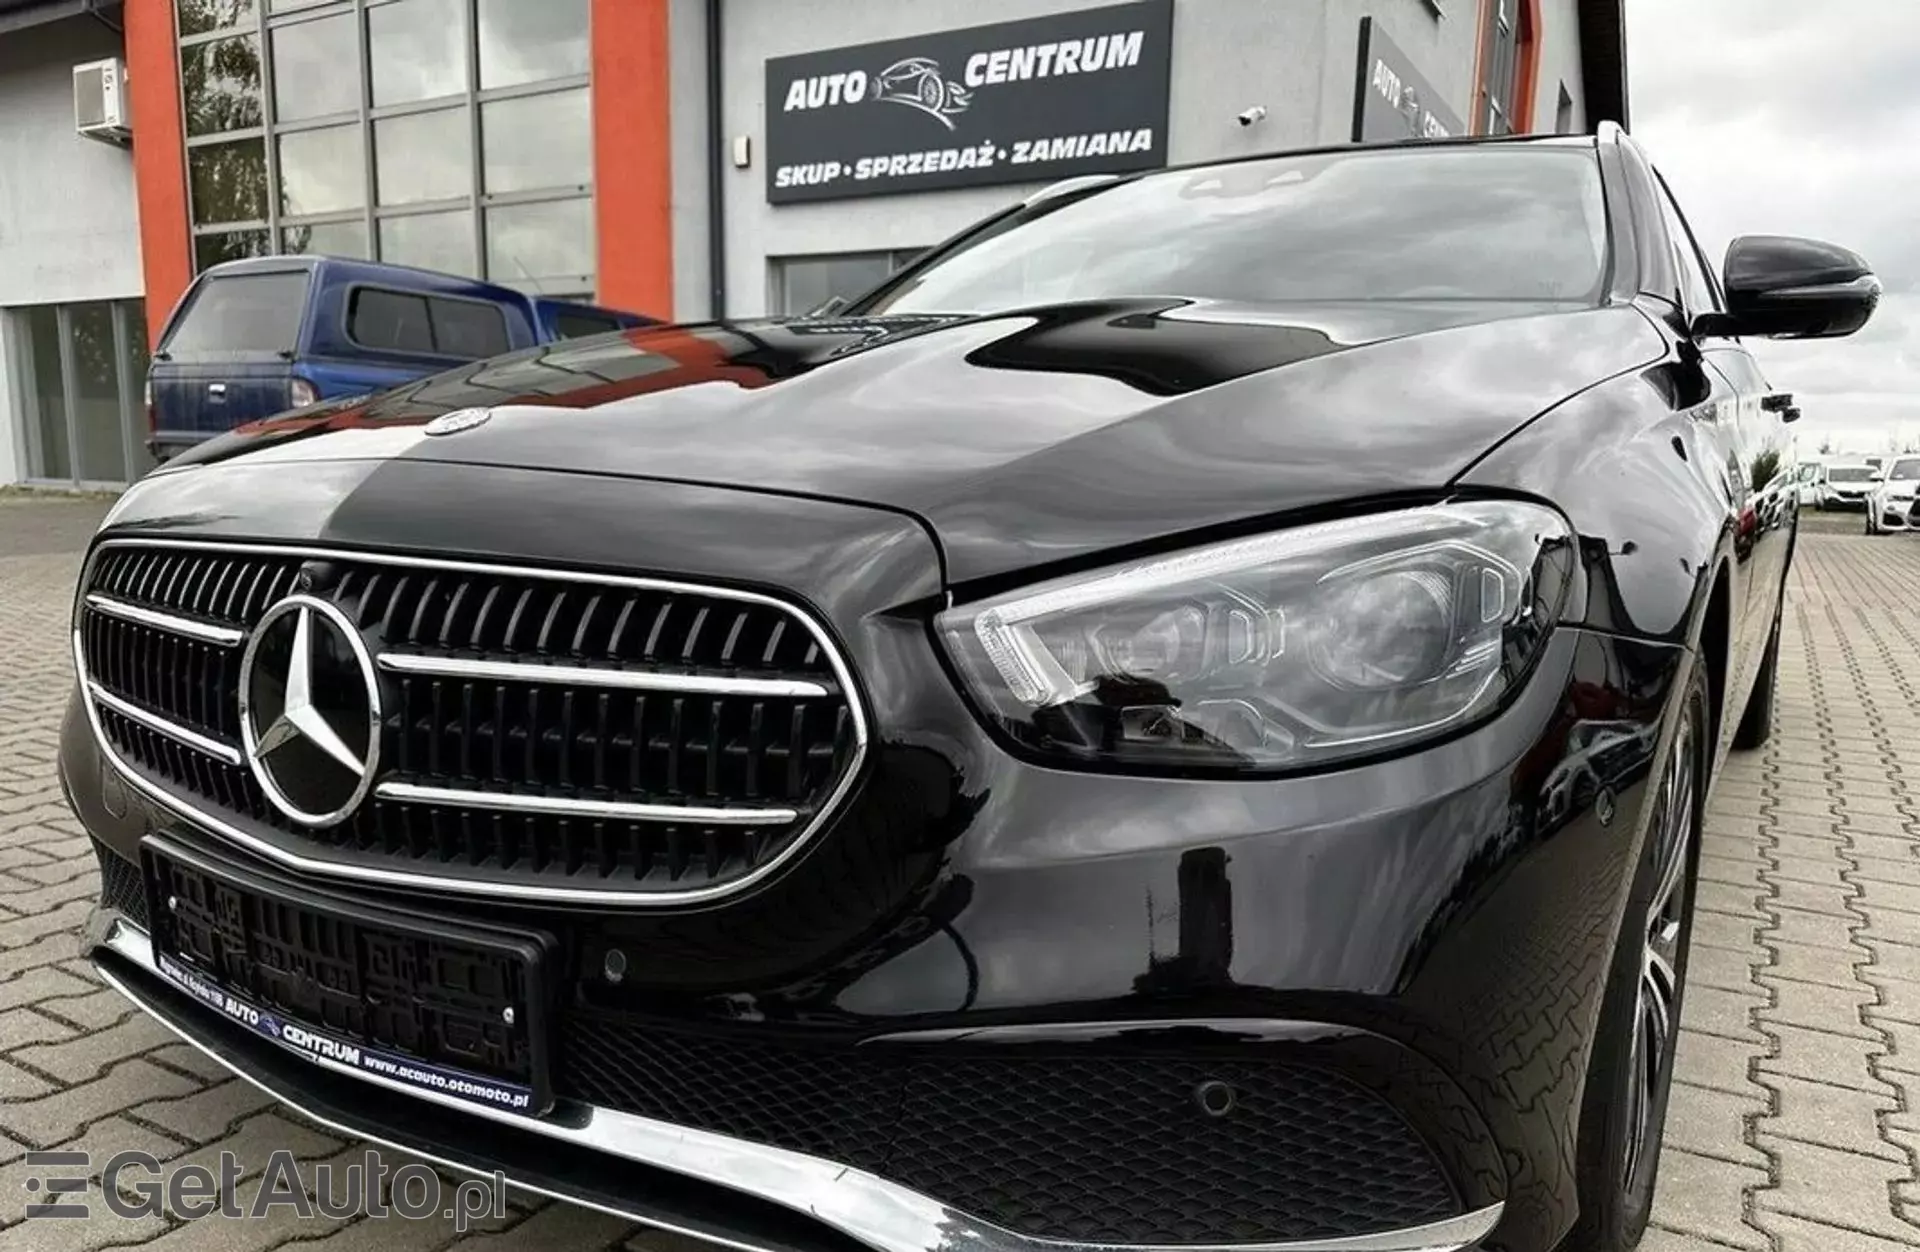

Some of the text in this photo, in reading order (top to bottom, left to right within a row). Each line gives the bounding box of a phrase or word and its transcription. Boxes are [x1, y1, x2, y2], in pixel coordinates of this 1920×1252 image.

[783, 30, 1145, 112] AUTO CENTRUM
[1372, 58, 1401, 109] AUTO
[774, 128, 1153, 189] SKUP SPRZEDAŻ ZAMIANA
[224, 996, 529, 1108] AUTO CENTRUM www.acauto.otomoto.pl
